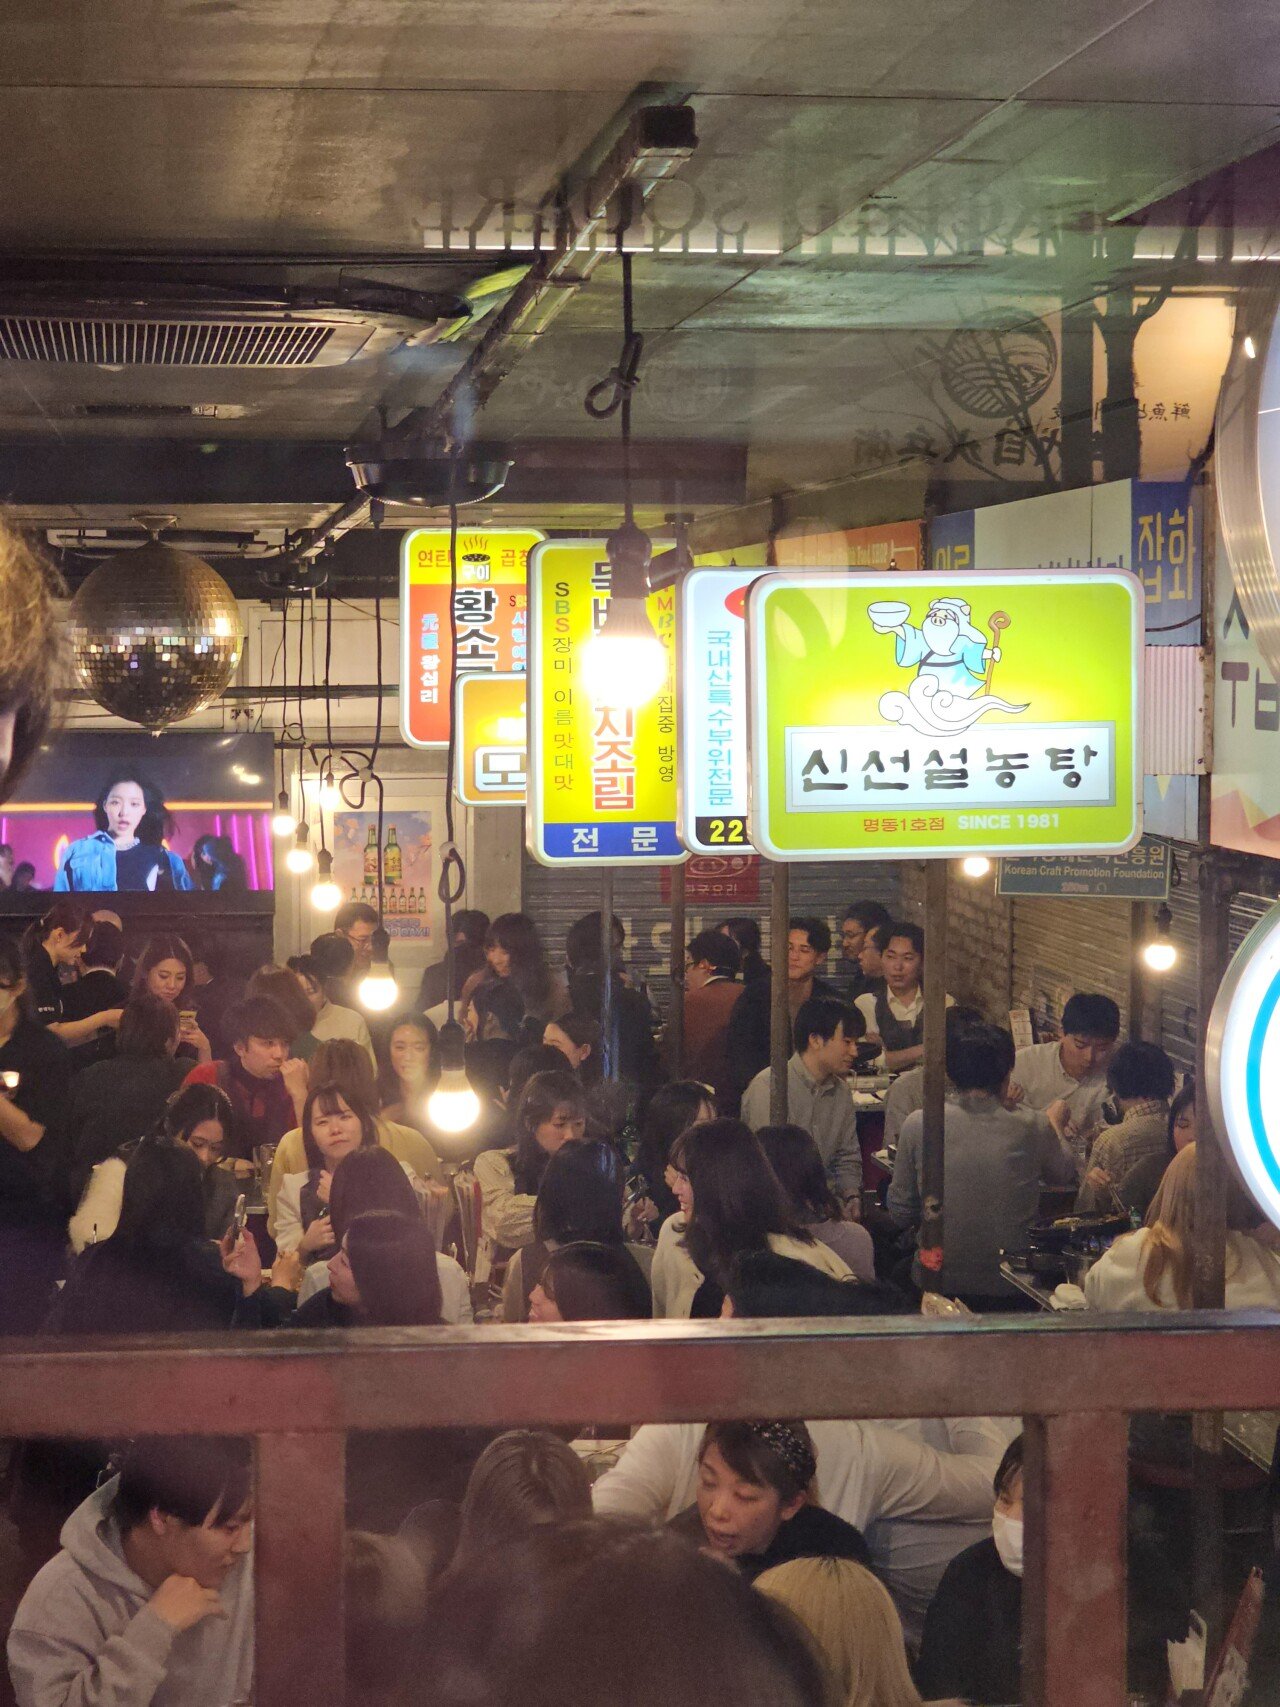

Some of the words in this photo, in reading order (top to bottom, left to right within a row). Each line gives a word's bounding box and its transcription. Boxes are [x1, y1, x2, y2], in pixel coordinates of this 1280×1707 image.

[1139, 505, 1196, 603] 잡화
[455, 590, 497, 671] 황소
[801, 746, 1098, 792] 신선설농탕
[863, 816, 945, 833] 명동1호점
[958, 814, 1011, 830] SINCE
[1017, 813, 1059, 829] 1981
[1004, 864, 1037, 876] Korean
[1039, 865, 1061, 877] Craft
[1063, 867, 1111, 878] Promotion
[1113, 868, 1164, 879] Foundation
